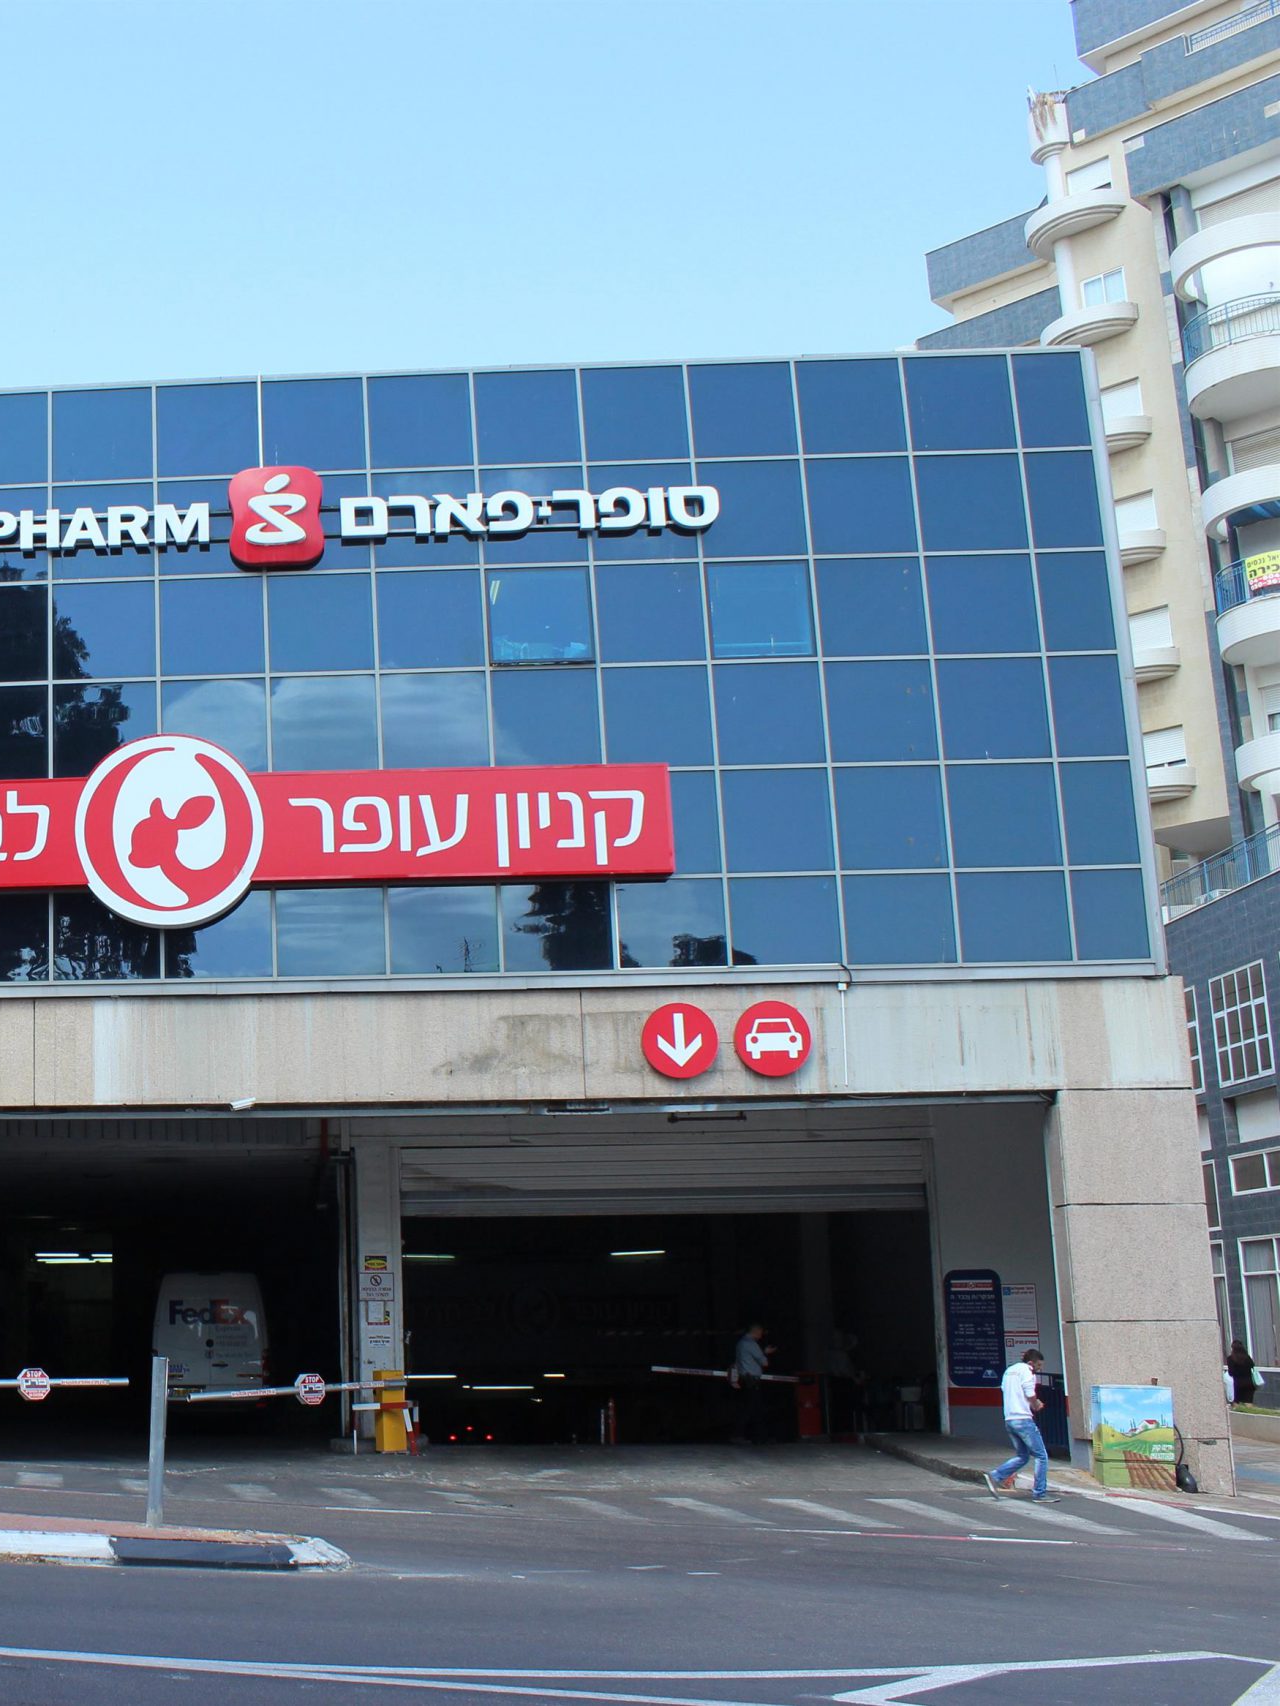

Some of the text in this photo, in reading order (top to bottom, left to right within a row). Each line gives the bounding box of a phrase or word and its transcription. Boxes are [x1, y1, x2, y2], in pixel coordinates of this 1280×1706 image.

[339, 485, 720, 539] סופר-פארם
[1247, 557, 1266, 569] נכסים
[1249, 563, 1280, 579] כירה
[287, 788, 645, 868] קניון עופר
[169, 1299, 250, 1325] FedEx
[26, 1370, 42, 1378] STOP
